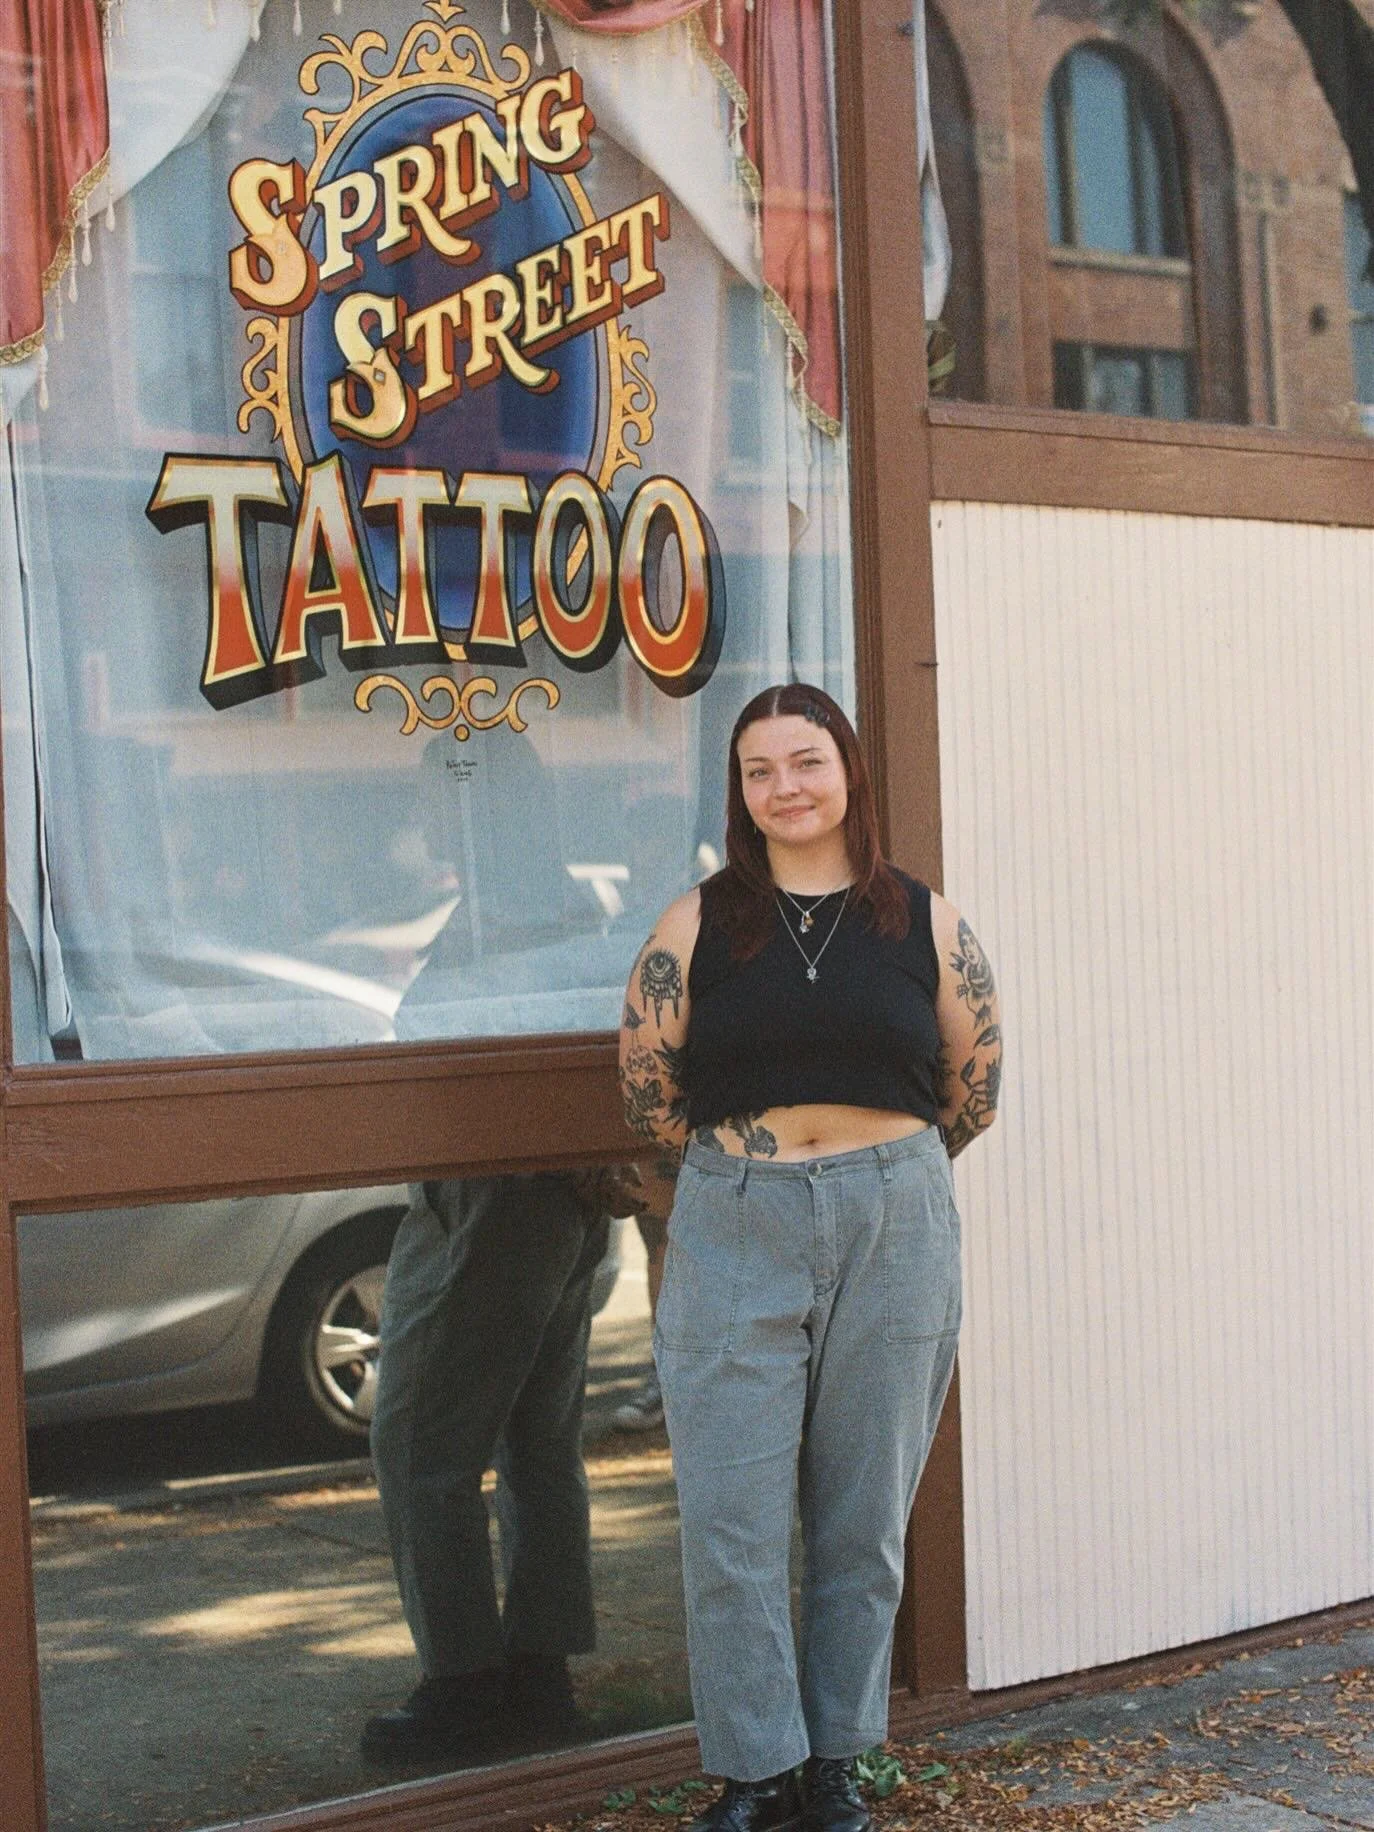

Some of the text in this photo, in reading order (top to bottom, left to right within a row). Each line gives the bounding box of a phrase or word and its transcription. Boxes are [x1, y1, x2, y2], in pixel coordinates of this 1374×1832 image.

[229, 69, 595, 316] SPRING
[331, 195, 670, 446] STREET
[146, 450, 727, 709] TATTOO
